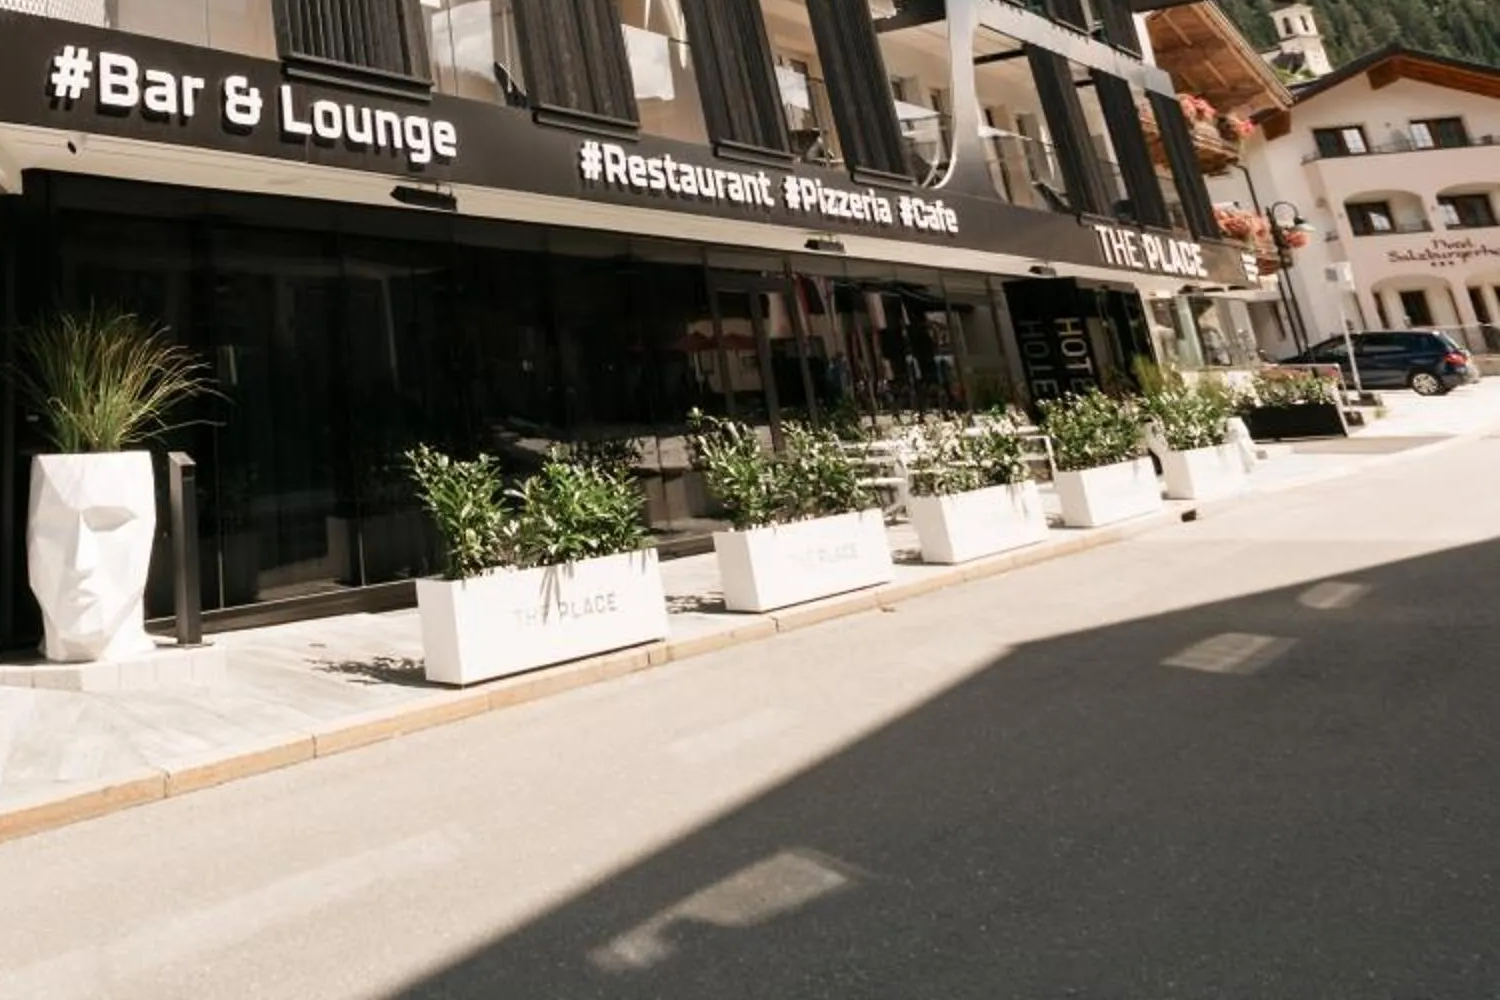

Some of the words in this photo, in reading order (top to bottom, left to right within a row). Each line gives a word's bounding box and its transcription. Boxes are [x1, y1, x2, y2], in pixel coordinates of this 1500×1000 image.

[51, 45, 205, 117] #Bar
[225, 75, 263, 125] &
[280, 85, 457, 163] Lounge
[581, 141, 775, 207] #Restaurant
[784, 175, 893, 224] #Pizzeria
[899, 195, 959, 233] #Cafe
[1094, 224, 1145, 268] THE
[1141, 233, 1208, 277] PLACE
[558, 592, 617, 623] PLACE
